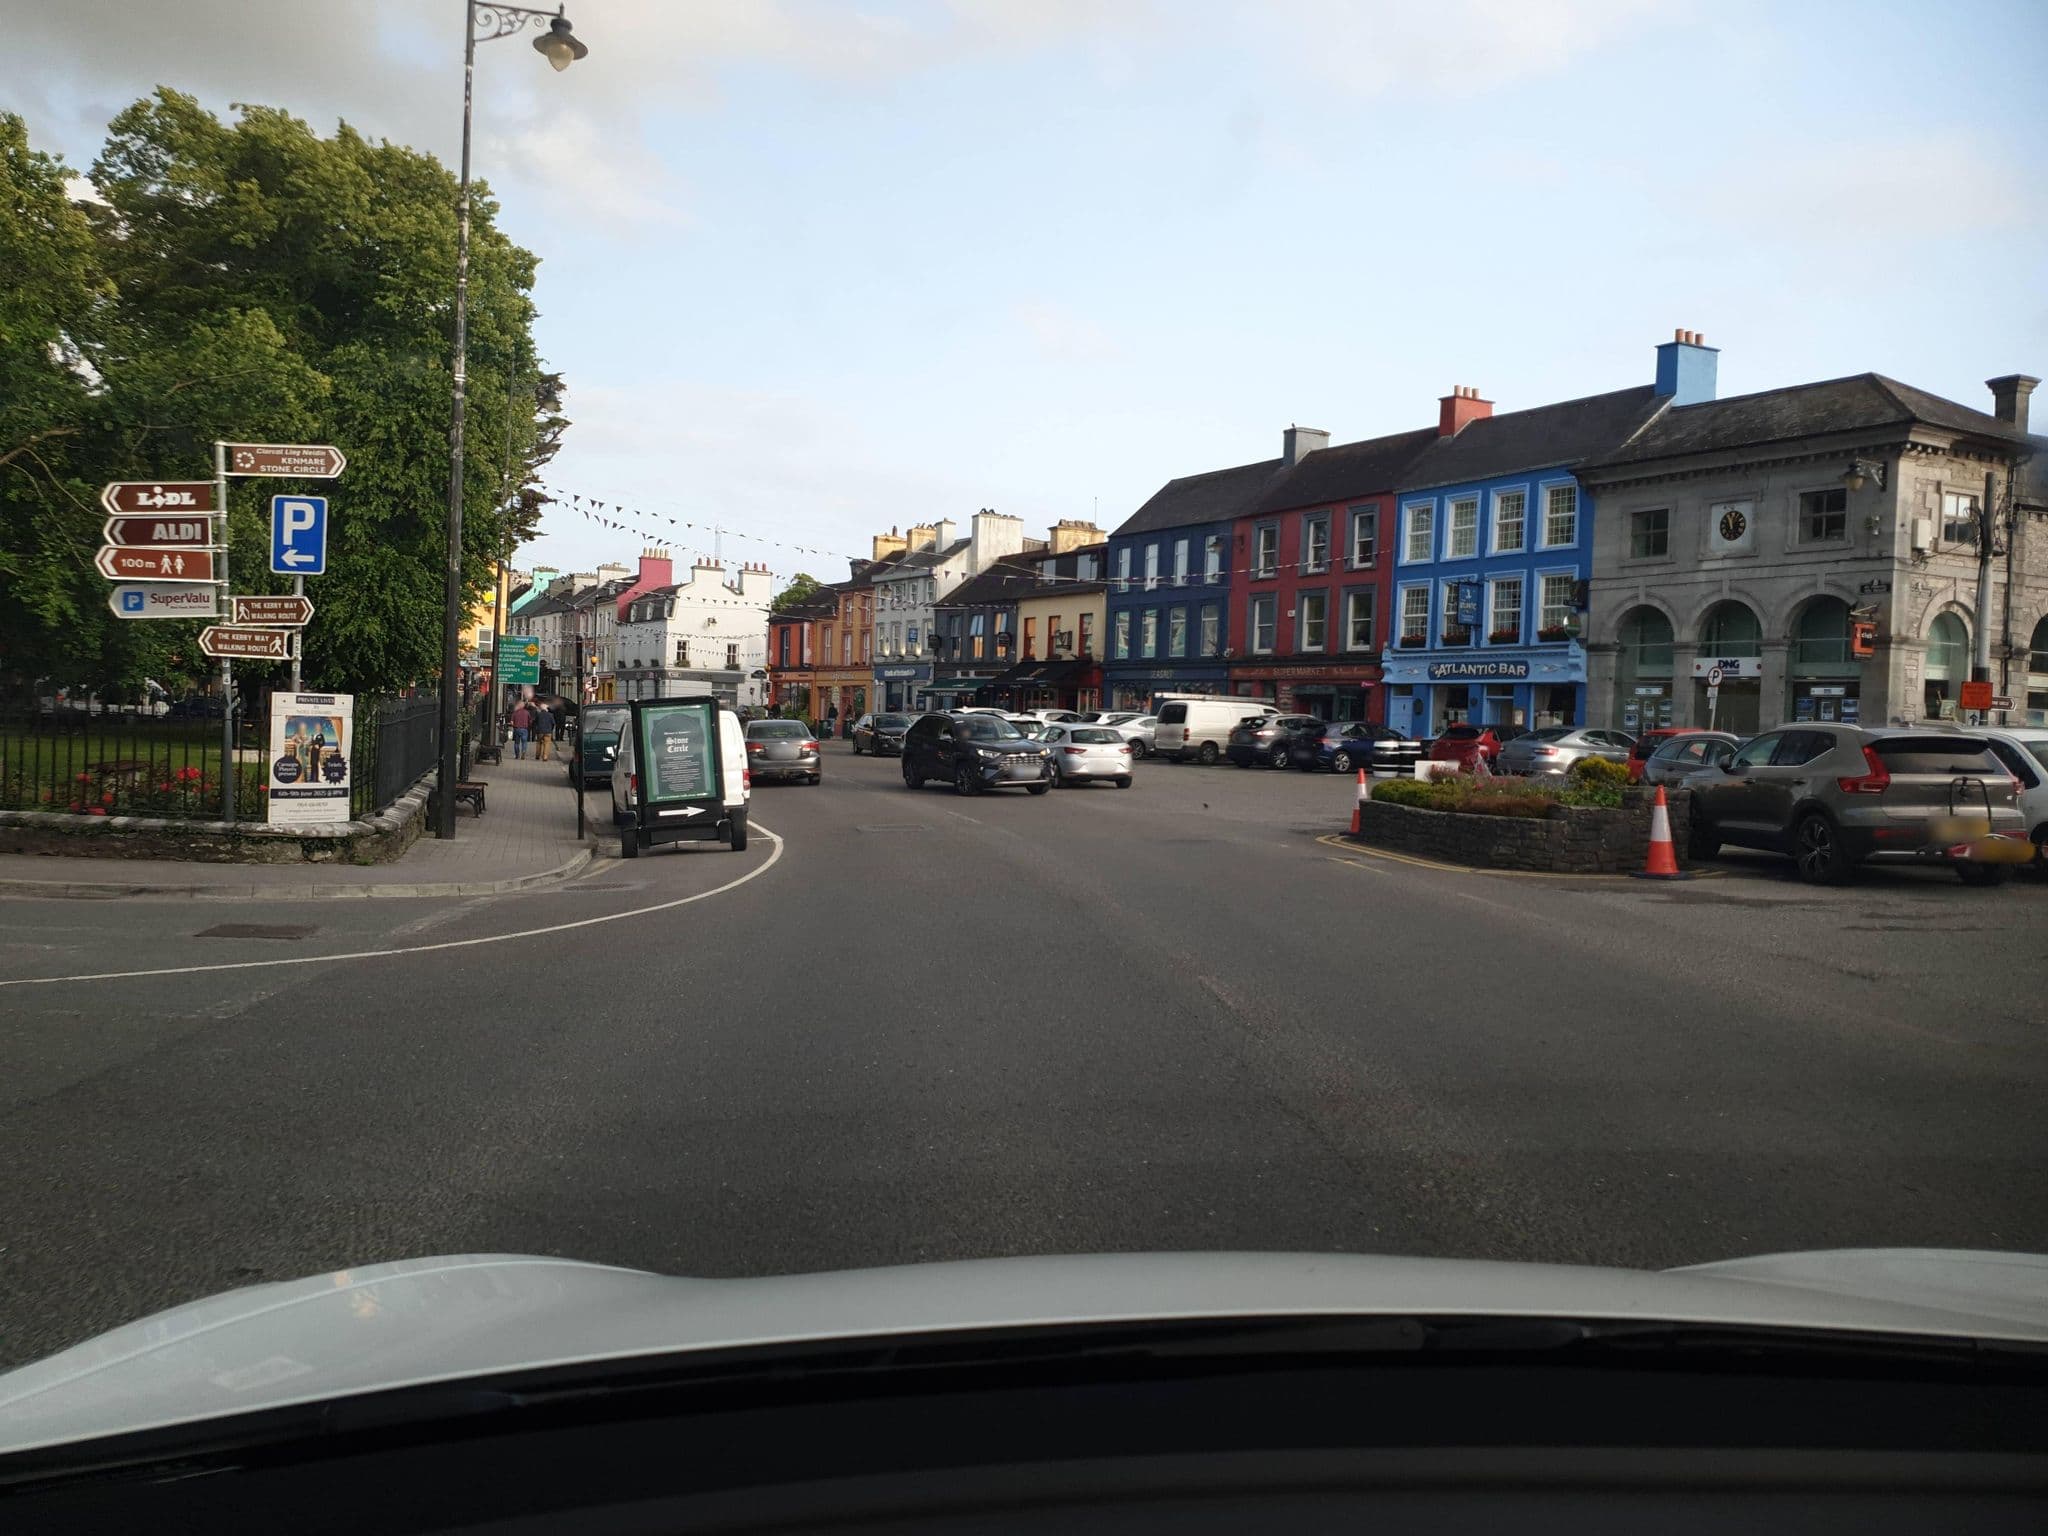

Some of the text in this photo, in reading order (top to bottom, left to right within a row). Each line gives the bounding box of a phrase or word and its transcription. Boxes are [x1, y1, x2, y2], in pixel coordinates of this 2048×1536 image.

[281, 457, 326, 465] KENMARE
[260, 465, 326, 474] STONE CIRCLE
[283, 502, 316, 545] P
[152, 523, 202, 540] ALDI
[128, 593, 210, 608] P SuperValu
[217, 632, 229, 640] THE
[231, 633, 252, 641] KERRY
[217, 643, 268, 653] WALKING ROUTE
[1717, 659, 1740, 669] DNG
[1272, 666, 1327, 676] SUPERMARKET
[1434, 662, 1497, 678] ATLANTIC
[1498, 662, 1526, 675] BAR
[1712, 670, 1720, 683] P
[665, 736, 689, 745] Stone
[667, 745, 689, 753] Circle
